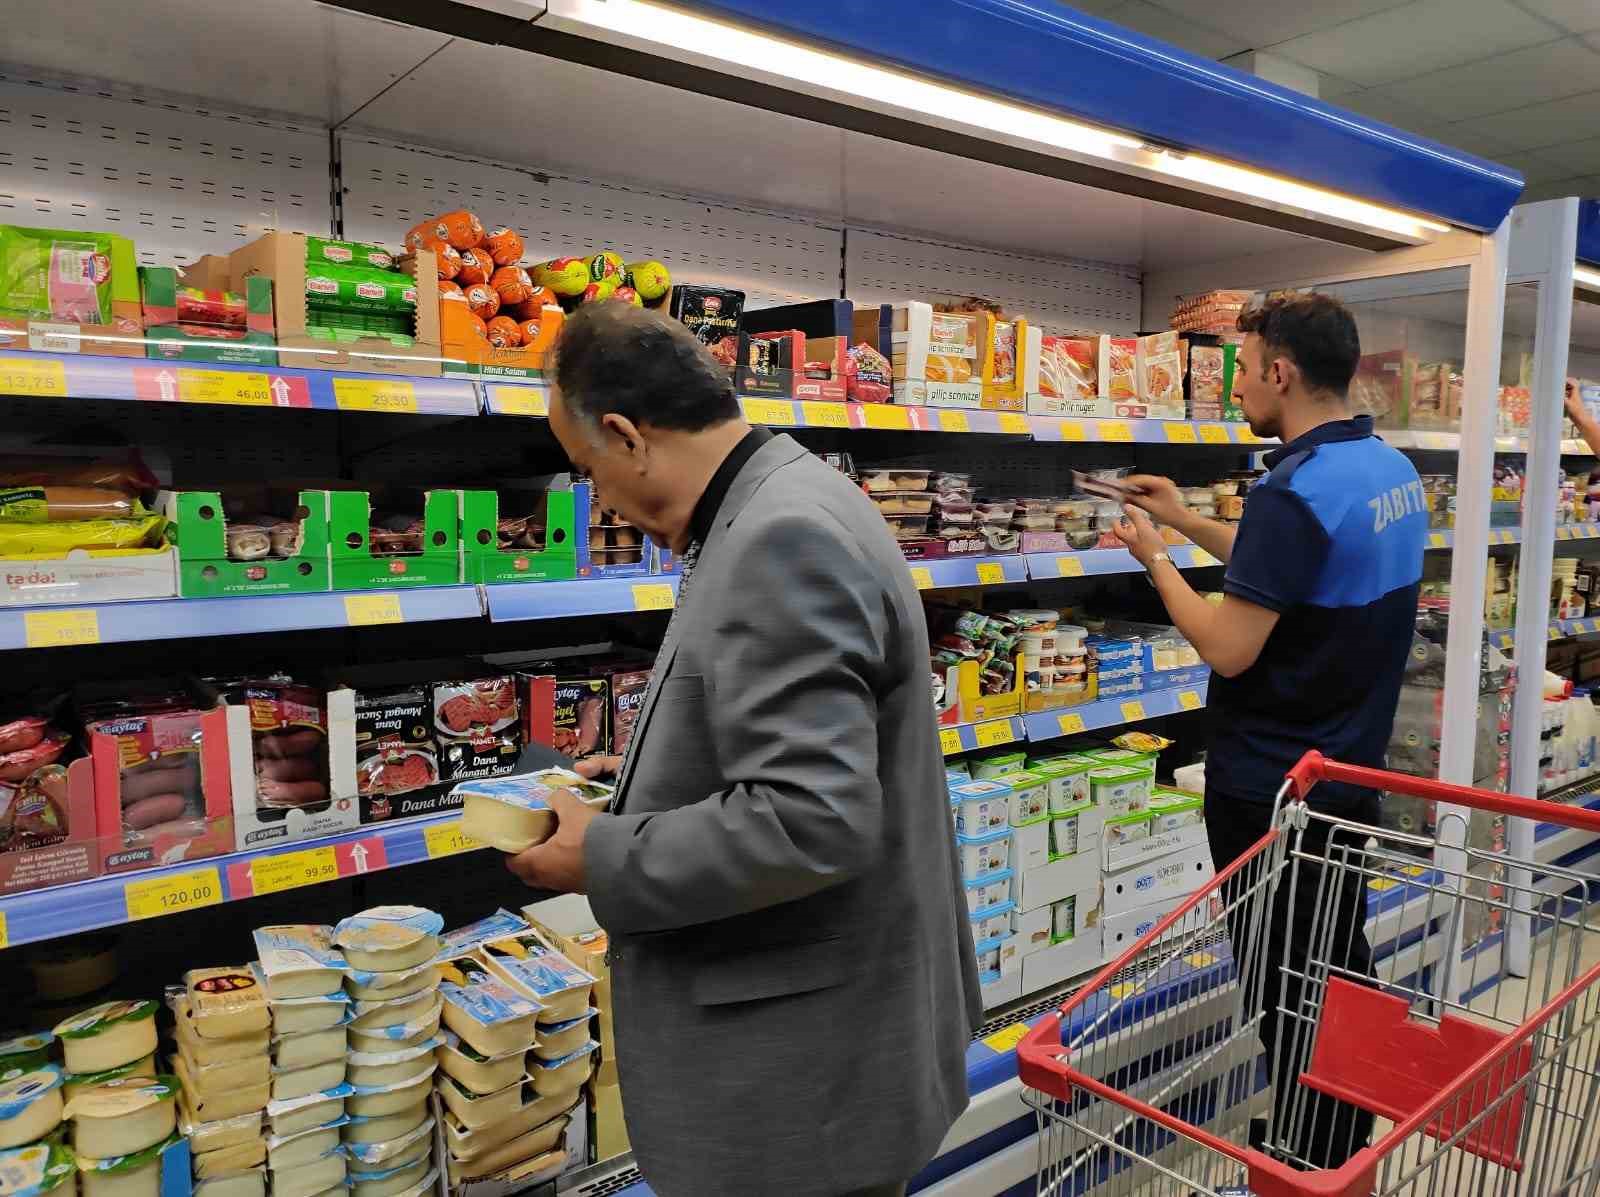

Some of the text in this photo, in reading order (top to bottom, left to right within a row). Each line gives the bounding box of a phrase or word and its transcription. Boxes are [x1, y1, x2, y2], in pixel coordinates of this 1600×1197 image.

[483, 366, 527, 376] Hindi Salam
[384, 706, 422, 719] Mangal
[374, 720, 402, 730] Dana
[473, 756, 498, 767] Dana
[402, 799, 436, 813] Dana
[160, 886, 212, 907] 120,00
